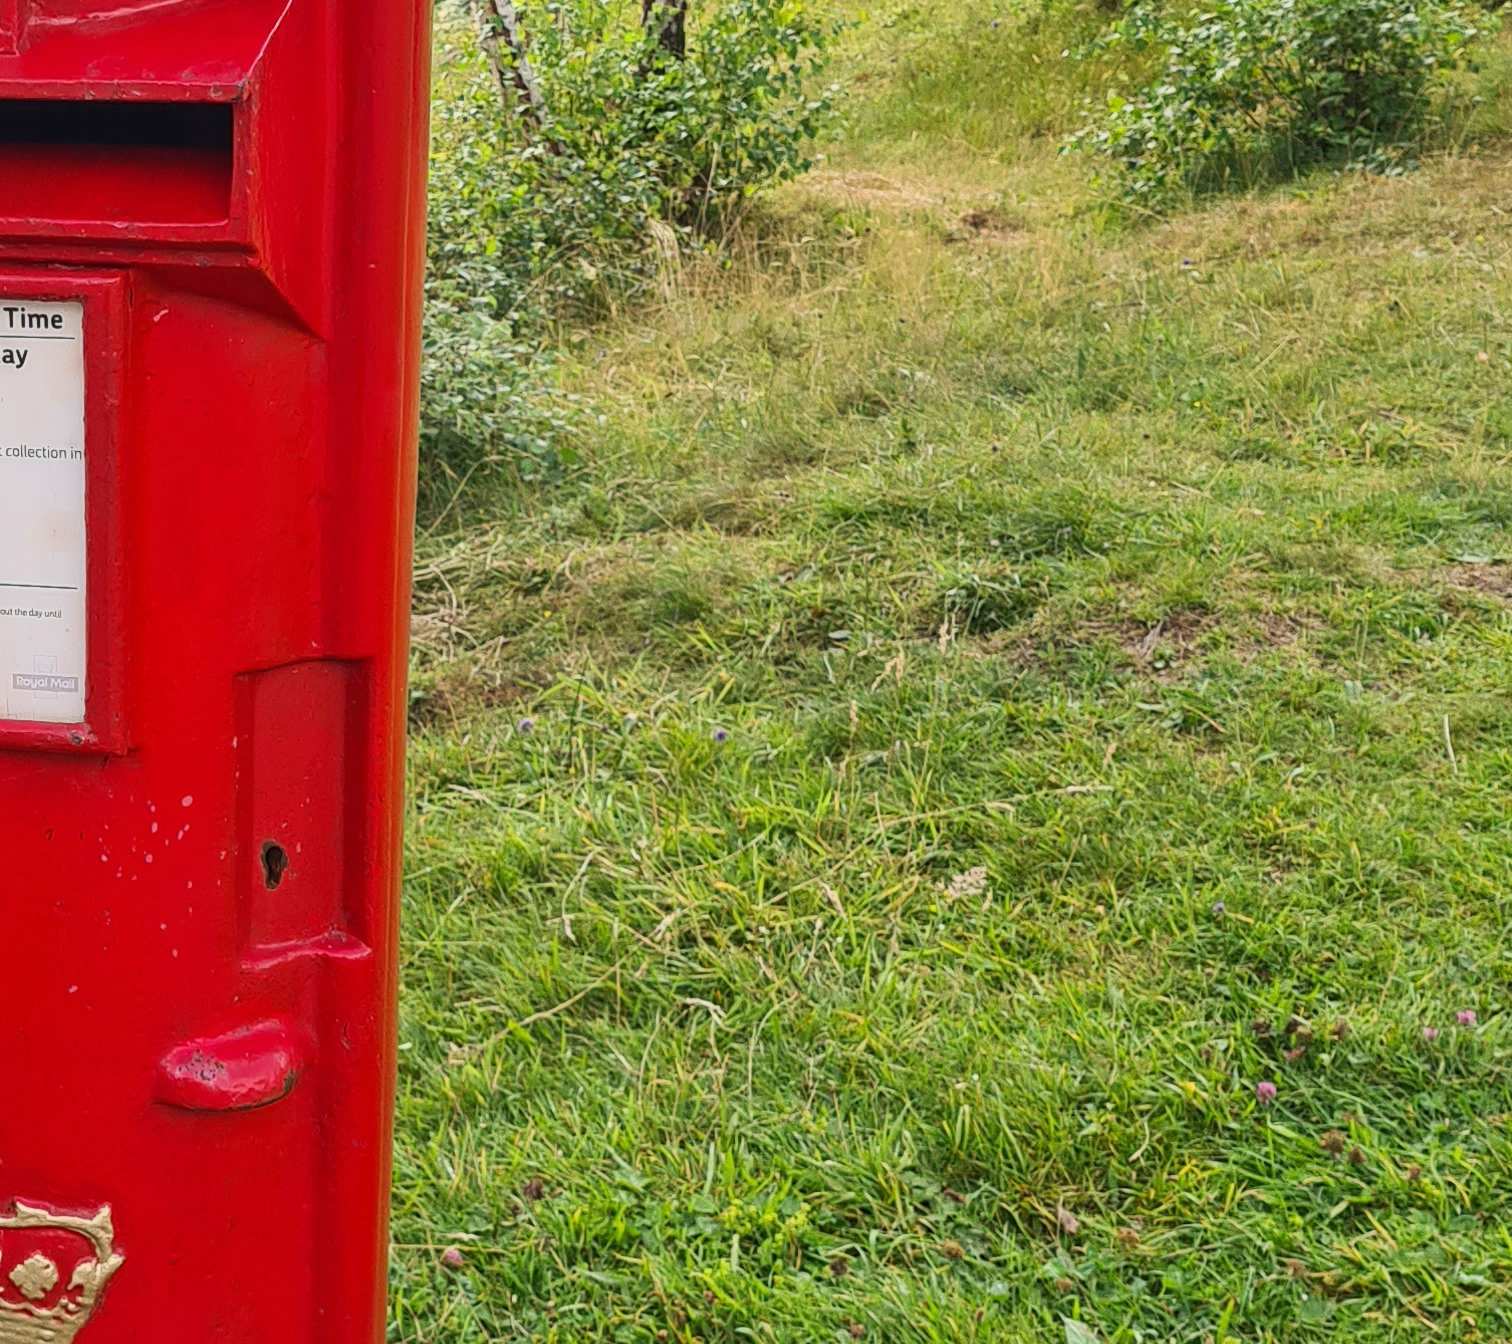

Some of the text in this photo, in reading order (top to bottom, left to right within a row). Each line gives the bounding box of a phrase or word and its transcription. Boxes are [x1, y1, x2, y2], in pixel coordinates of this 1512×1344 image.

[3, 307, 63, 329] Time
[6, 444, 67, 460] collection
[70, 448, 82, 461] in
[15, 608, 28, 616] the
[29, 608, 43, 618] day
[44, 610, 62, 619] until
[16, 675, 76, 690] Royal Mail
